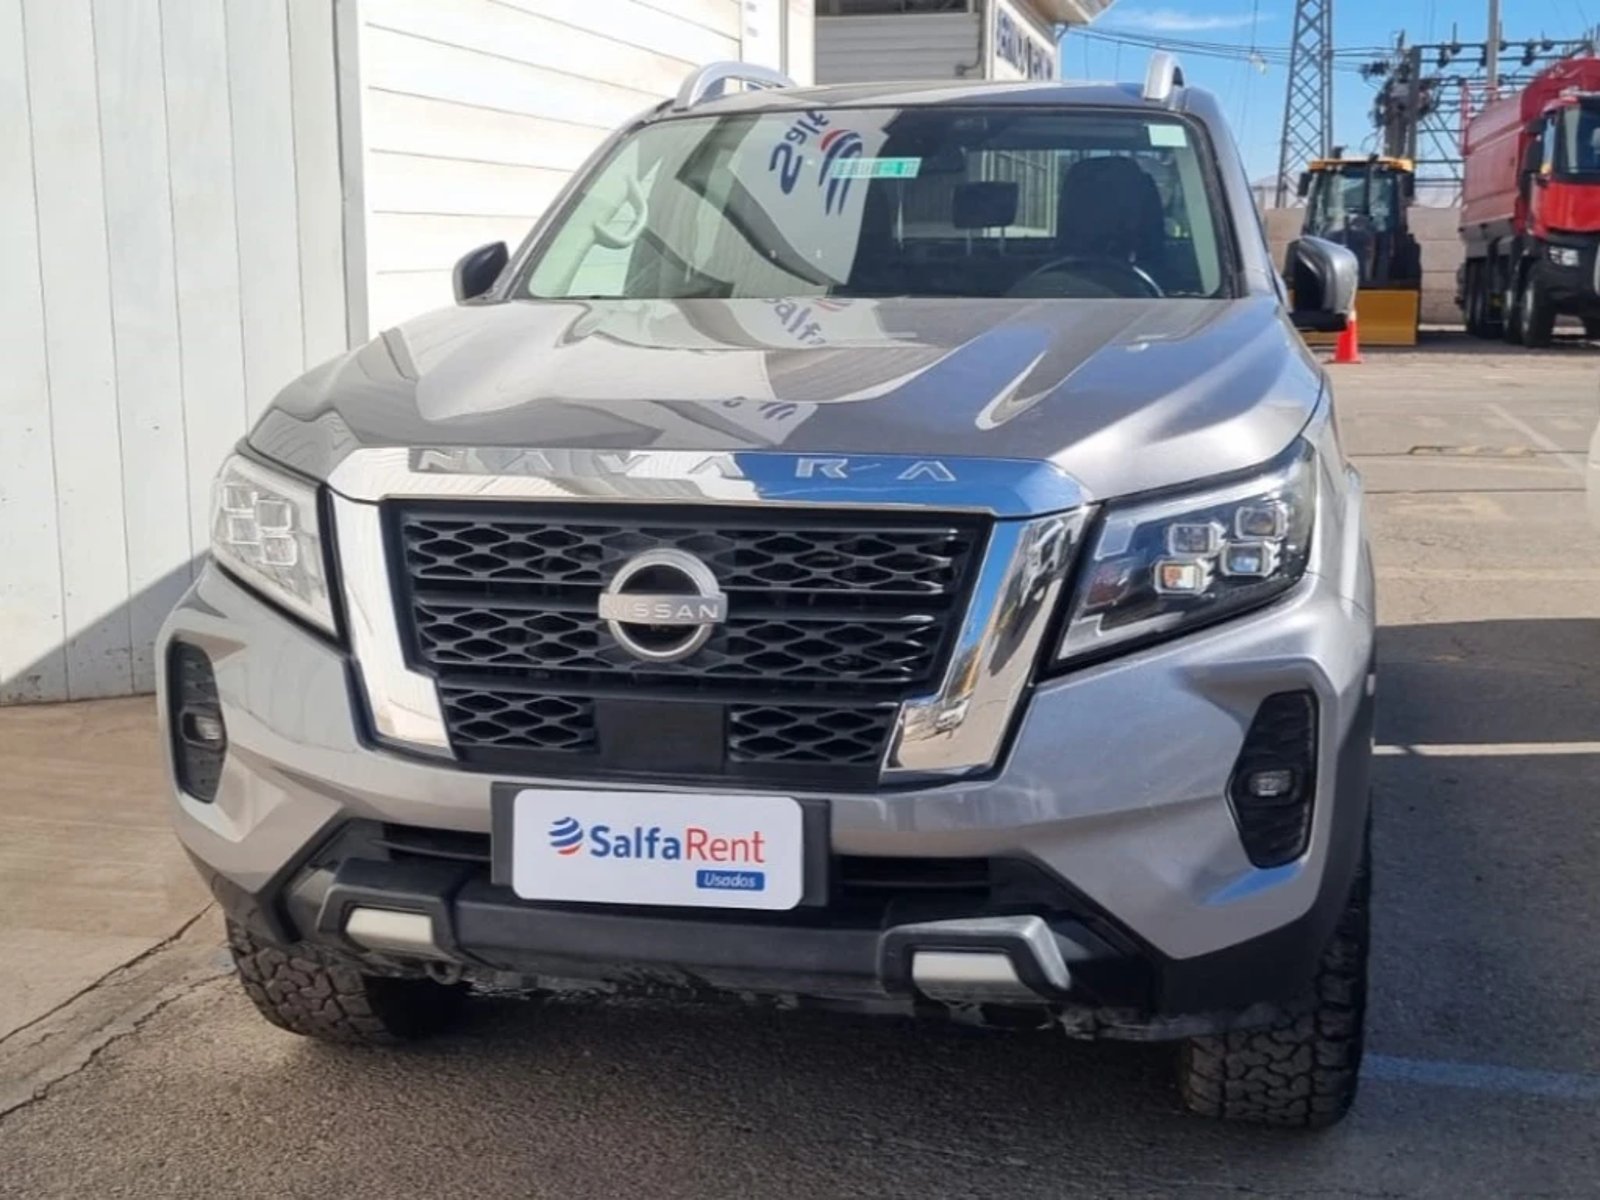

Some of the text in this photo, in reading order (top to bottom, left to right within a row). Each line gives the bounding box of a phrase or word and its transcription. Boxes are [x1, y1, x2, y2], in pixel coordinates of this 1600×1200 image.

[418, 450, 956, 482] NAVARA
[604, 602, 718, 619] NISSAN
[589, 825, 765, 863] SalfaRent
[704, 872, 756, 889] Usados
